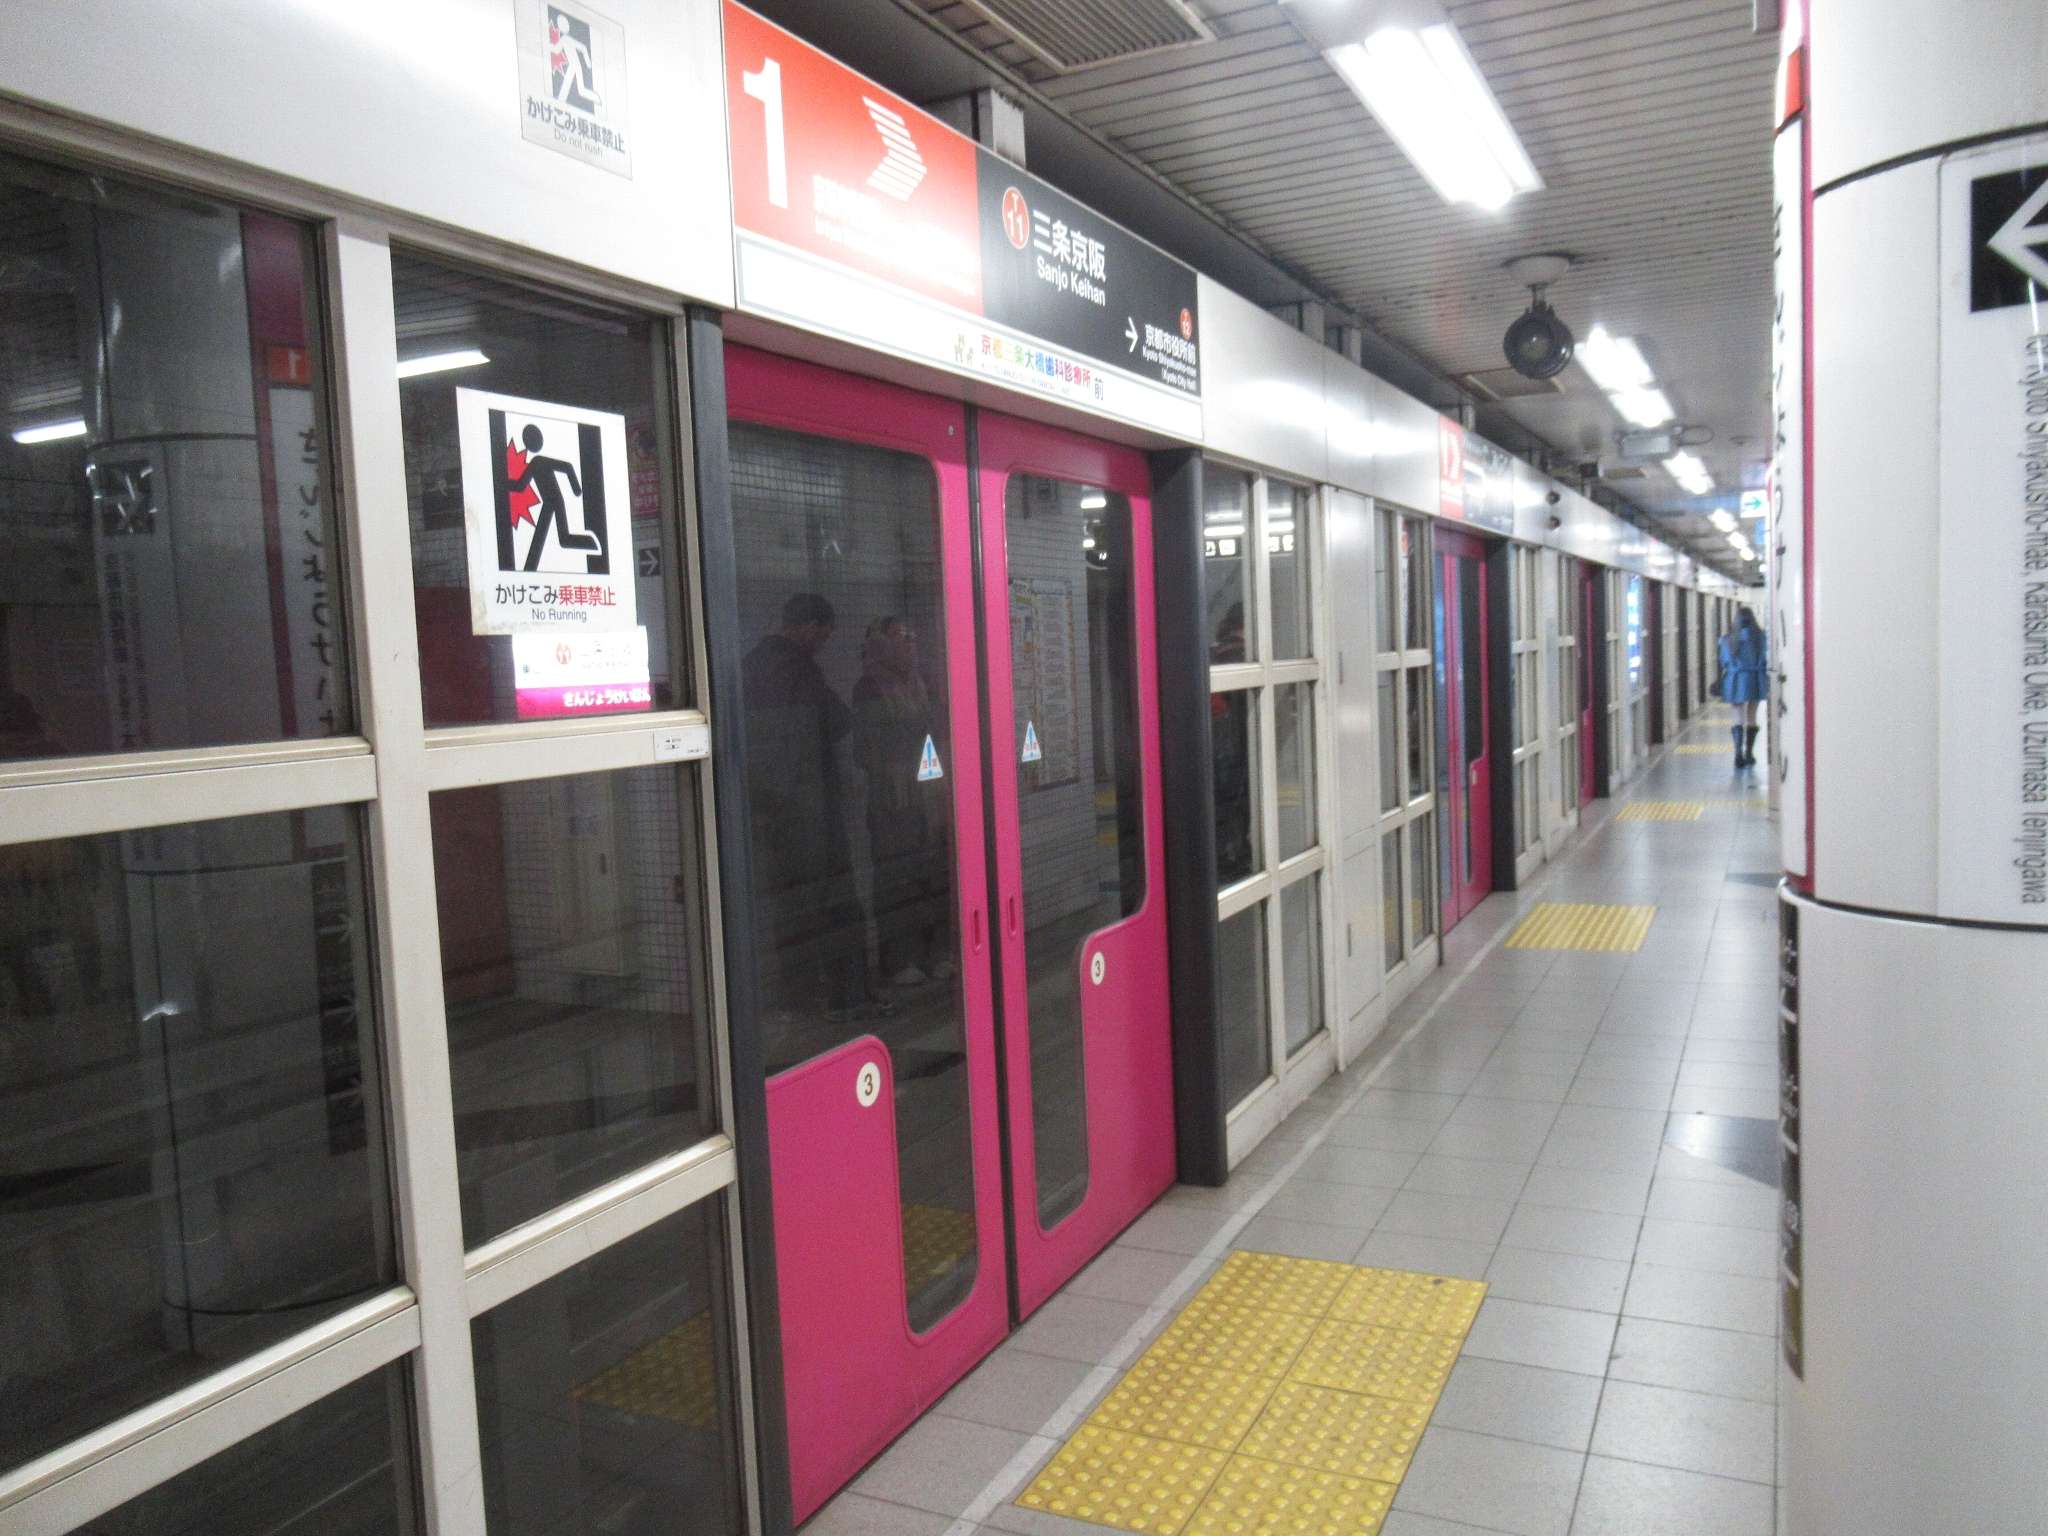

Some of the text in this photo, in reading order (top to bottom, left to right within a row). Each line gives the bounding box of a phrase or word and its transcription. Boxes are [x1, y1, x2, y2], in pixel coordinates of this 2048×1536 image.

[527, 95, 625, 154] かけこみ乗車禁止
[554, 128, 603, 157] Do not rush
[743, 57, 788, 209] 1
[1033, 209, 1106, 282] 三条京阪
[1037, 255, 1105, 306] Sanjo Keihan
[496, 584, 616, 606] かけこみ乗車禁止
[532, 608, 588, 623] No Running
[2023, 581, 2048, 667] Karasuma
[2023, 721, 2048, 802] Uzumasa
[2013, 810, 2048, 905] Tenjingawa
[1095, 960, 1101, 977] 3
[864, 1073, 874, 1096] 3
